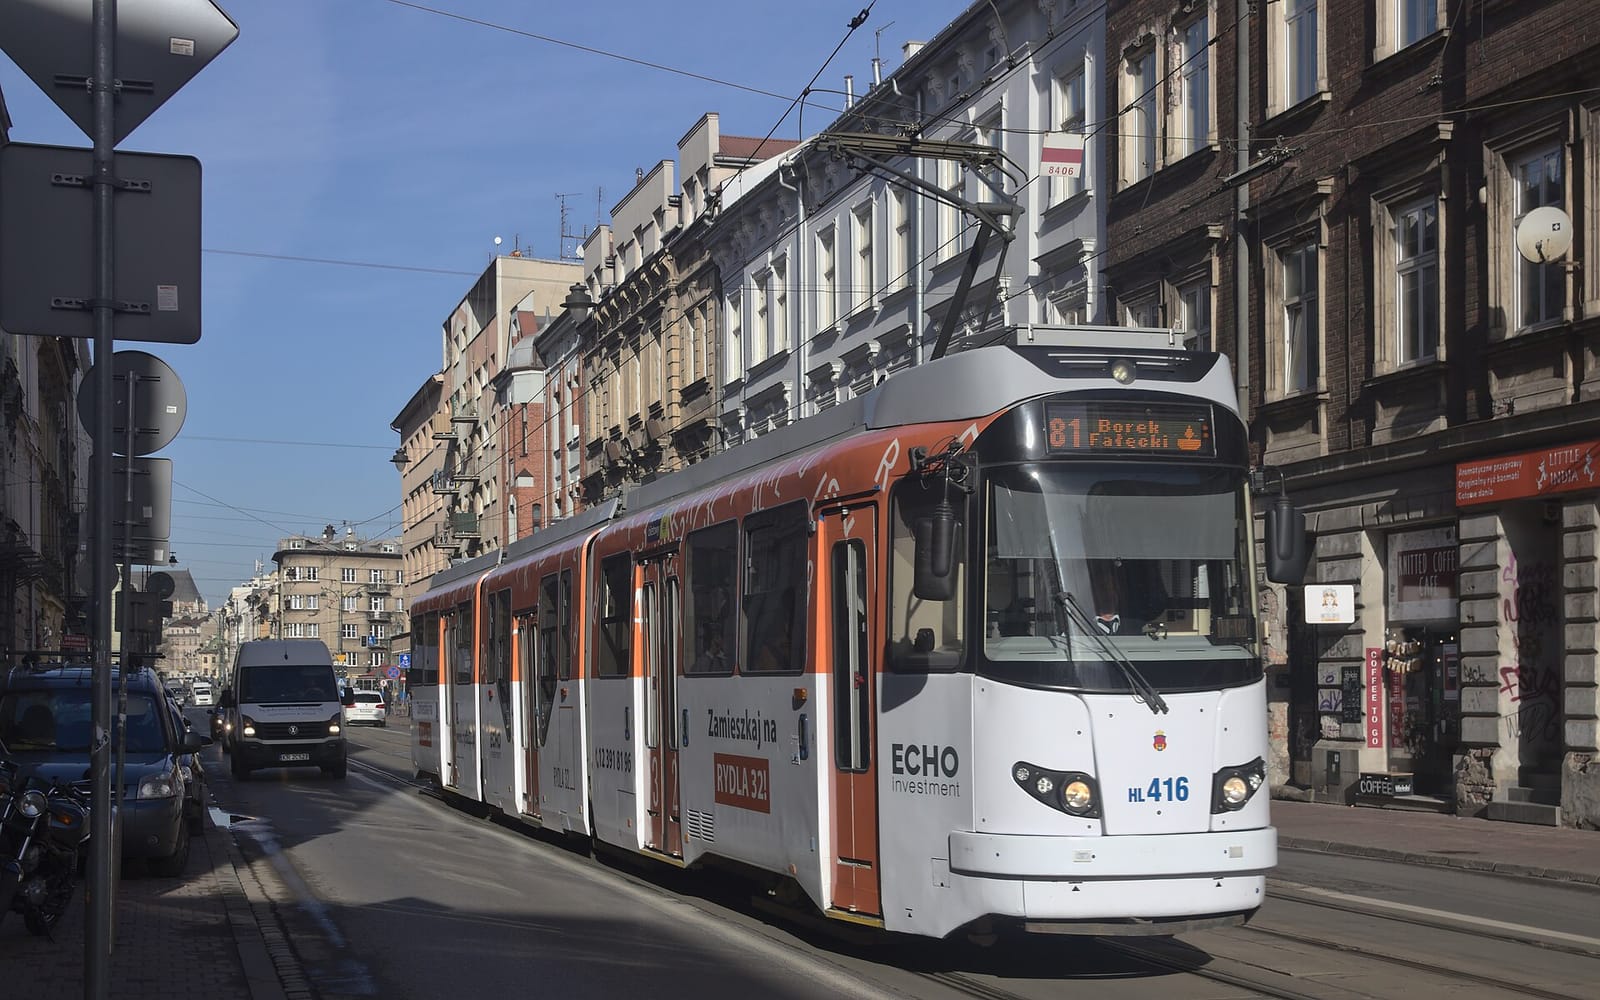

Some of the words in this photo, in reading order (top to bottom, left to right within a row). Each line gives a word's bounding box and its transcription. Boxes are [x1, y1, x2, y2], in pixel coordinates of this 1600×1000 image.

[1048, 166, 1074, 175] 8406
[1050, 418, 1081, 448] 81
[1098, 419, 1160, 434] Borek
[1549, 448, 1580, 466] LITTLE
[1550, 469, 1579, 485] INDIA
[1370, 651, 1378, 702] COFFEE
[1371, 707, 1378, 723] TO
[708, 709, 761, 749] Zamieszkaj
[763, 717, 777, 743] na
[1371, 729, 1379, 745] GO
[891, 743, 959, 778] ECHO
[717, 763, 749, 800] RYDLA
[751, 769, 767, 800] 32!
[891, 778, 960, 797] investment
[1128, 787, 1145, 803] HL
[1147, 776, 1189, 802] 416
[1360, 780, 1392, 795] COFFEE
